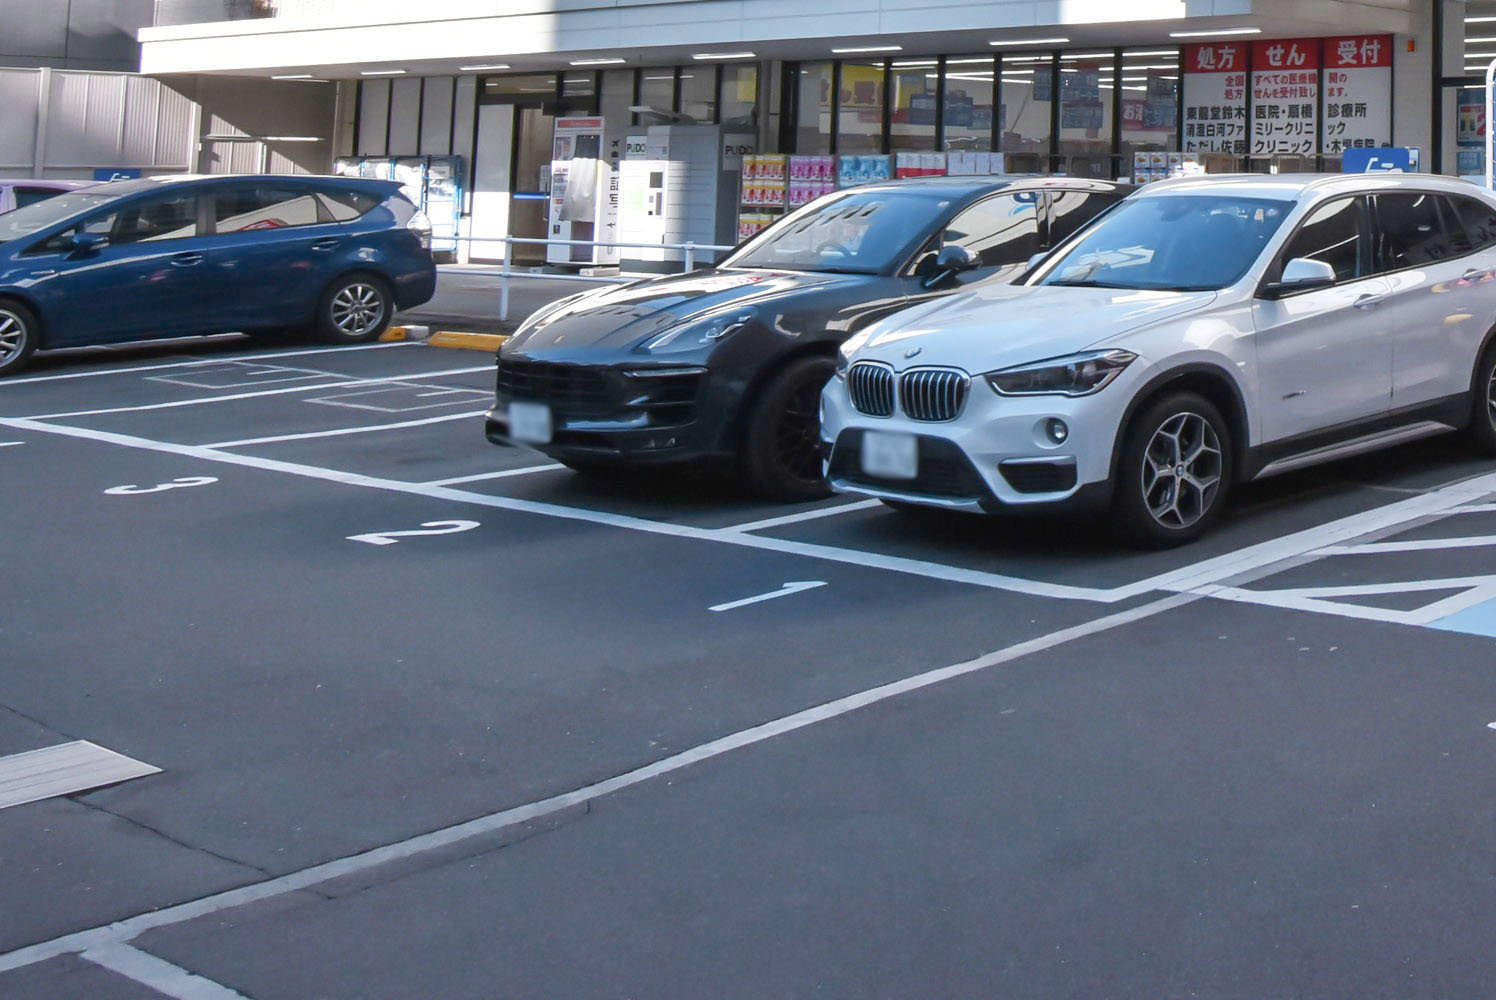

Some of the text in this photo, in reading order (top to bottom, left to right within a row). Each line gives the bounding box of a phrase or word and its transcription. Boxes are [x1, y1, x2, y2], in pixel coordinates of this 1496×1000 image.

[626, 143, 647, 153] PUDO
[103, 475, 219, 496] 3
[346, 519, 481, 546] 2
[708, 580, 828, 612] 1
